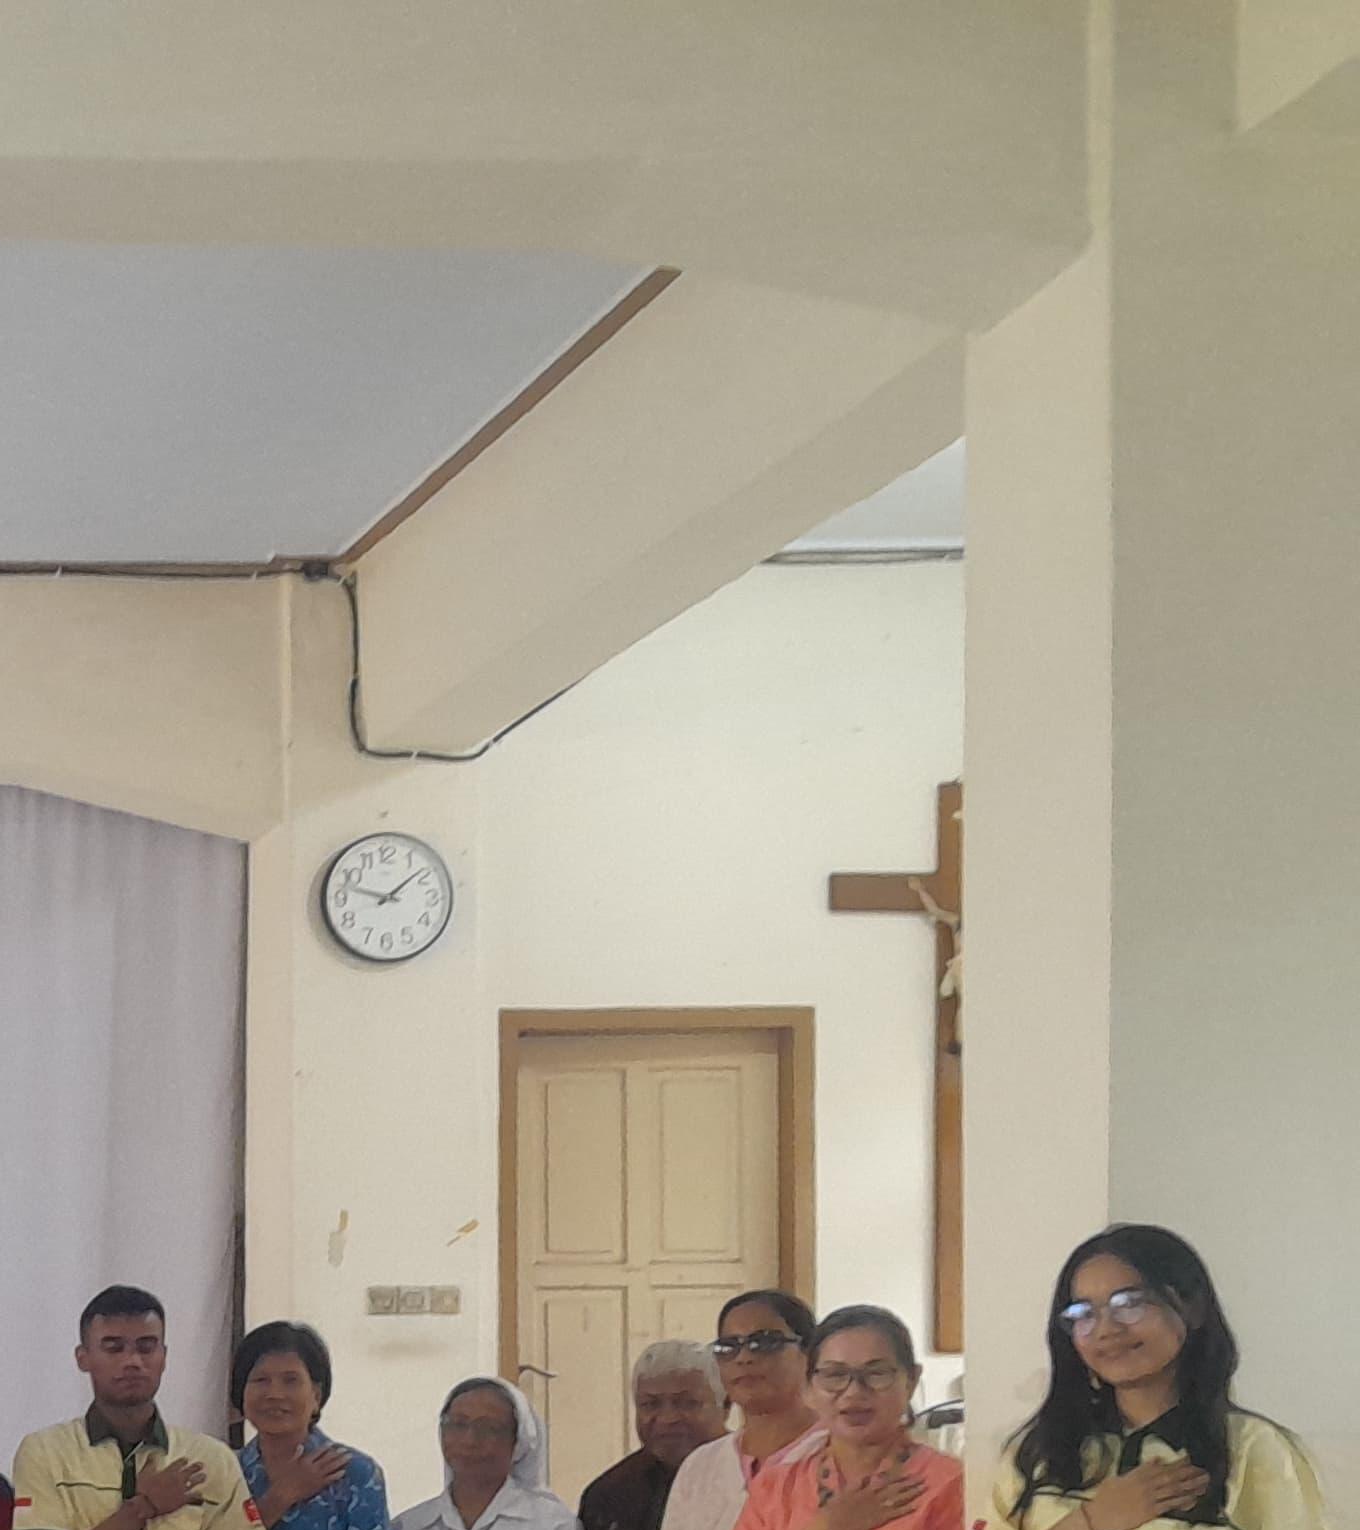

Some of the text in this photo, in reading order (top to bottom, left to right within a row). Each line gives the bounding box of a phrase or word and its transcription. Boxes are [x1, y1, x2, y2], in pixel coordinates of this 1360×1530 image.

[360, 851, 374, 870] 11
[379, 845, 397, 864] 12
[334, 888, 348, 908] 9
[424, 887, 440, 907] 3
[340, 910, 356, 929] 8
[417, 911, 430, 927] 4
[362, 926, 374, 945] 7
[380, 931, 393, 951] 6
[400, 926, 414, 945] 5
